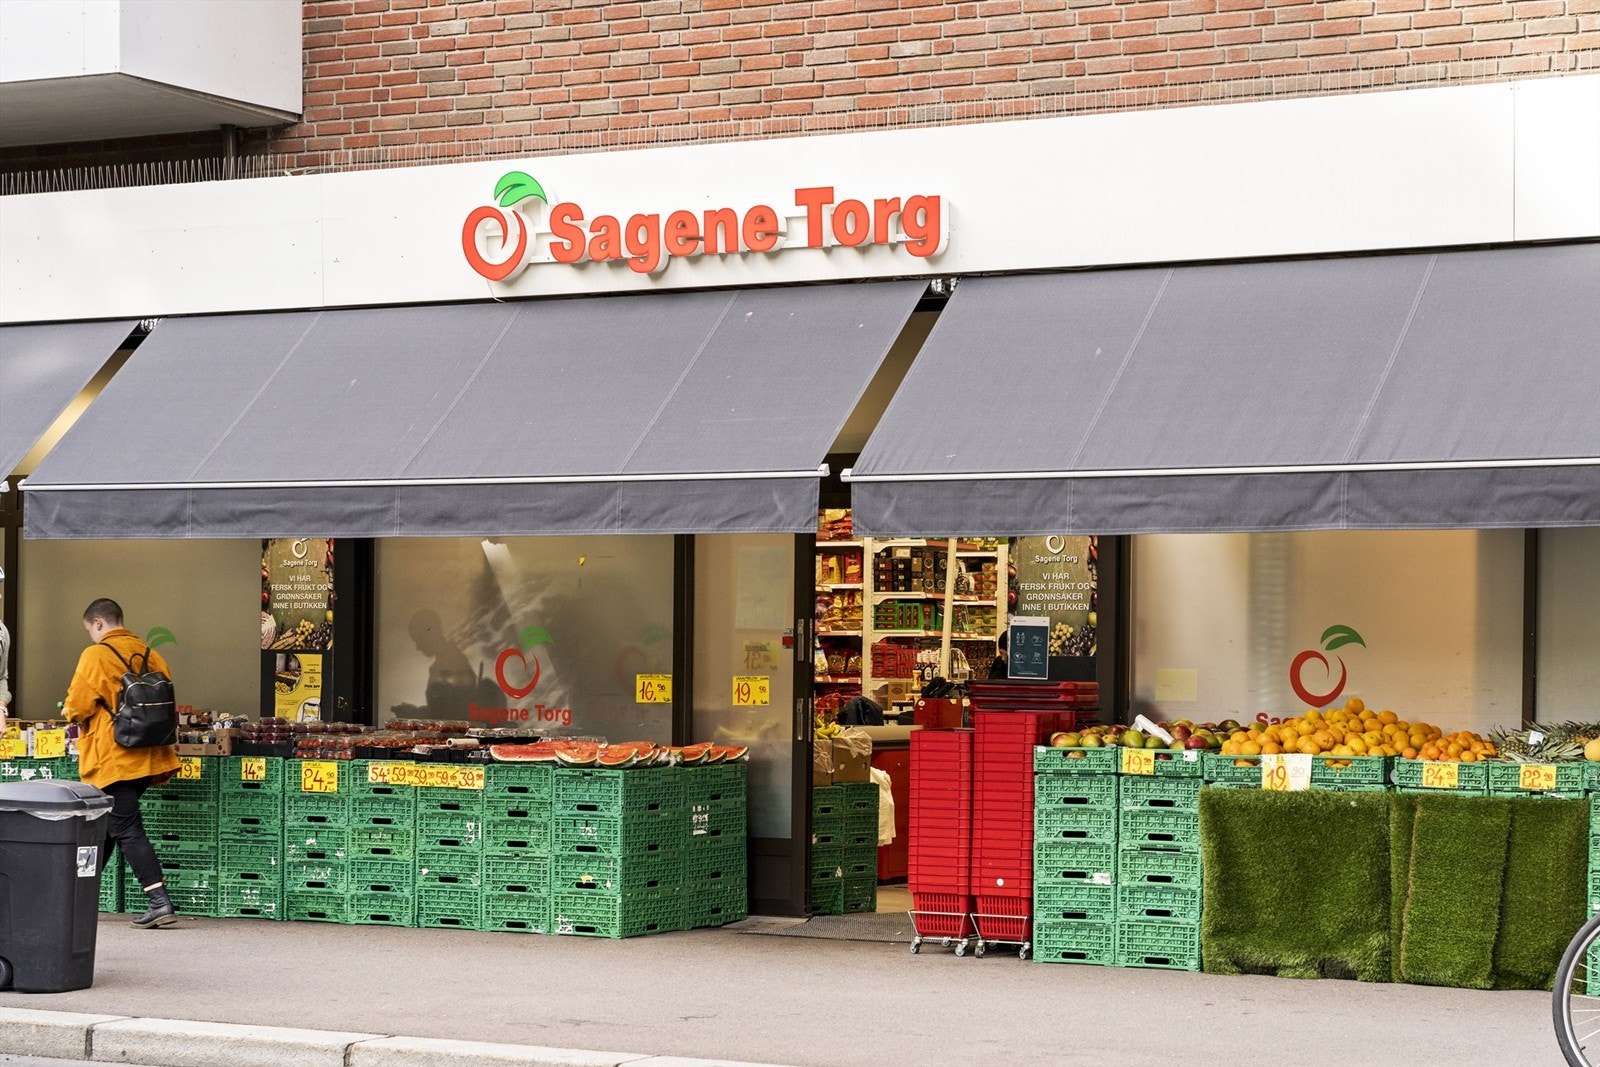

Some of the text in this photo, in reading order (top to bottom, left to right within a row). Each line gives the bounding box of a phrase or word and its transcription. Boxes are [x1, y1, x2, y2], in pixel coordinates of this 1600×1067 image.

[549, 186, 941, 274] Sagene Torg
[1035, 554, 1078, 564] Sagene Torg
[283, 560, 318, 568] Sagene Torg
[1026, 593, 1083, 601] GRØNNSAKER
[1048, 603, 1090, 611] BUTIKKEN
[468, 703, 572, 726] Sagene Torg
